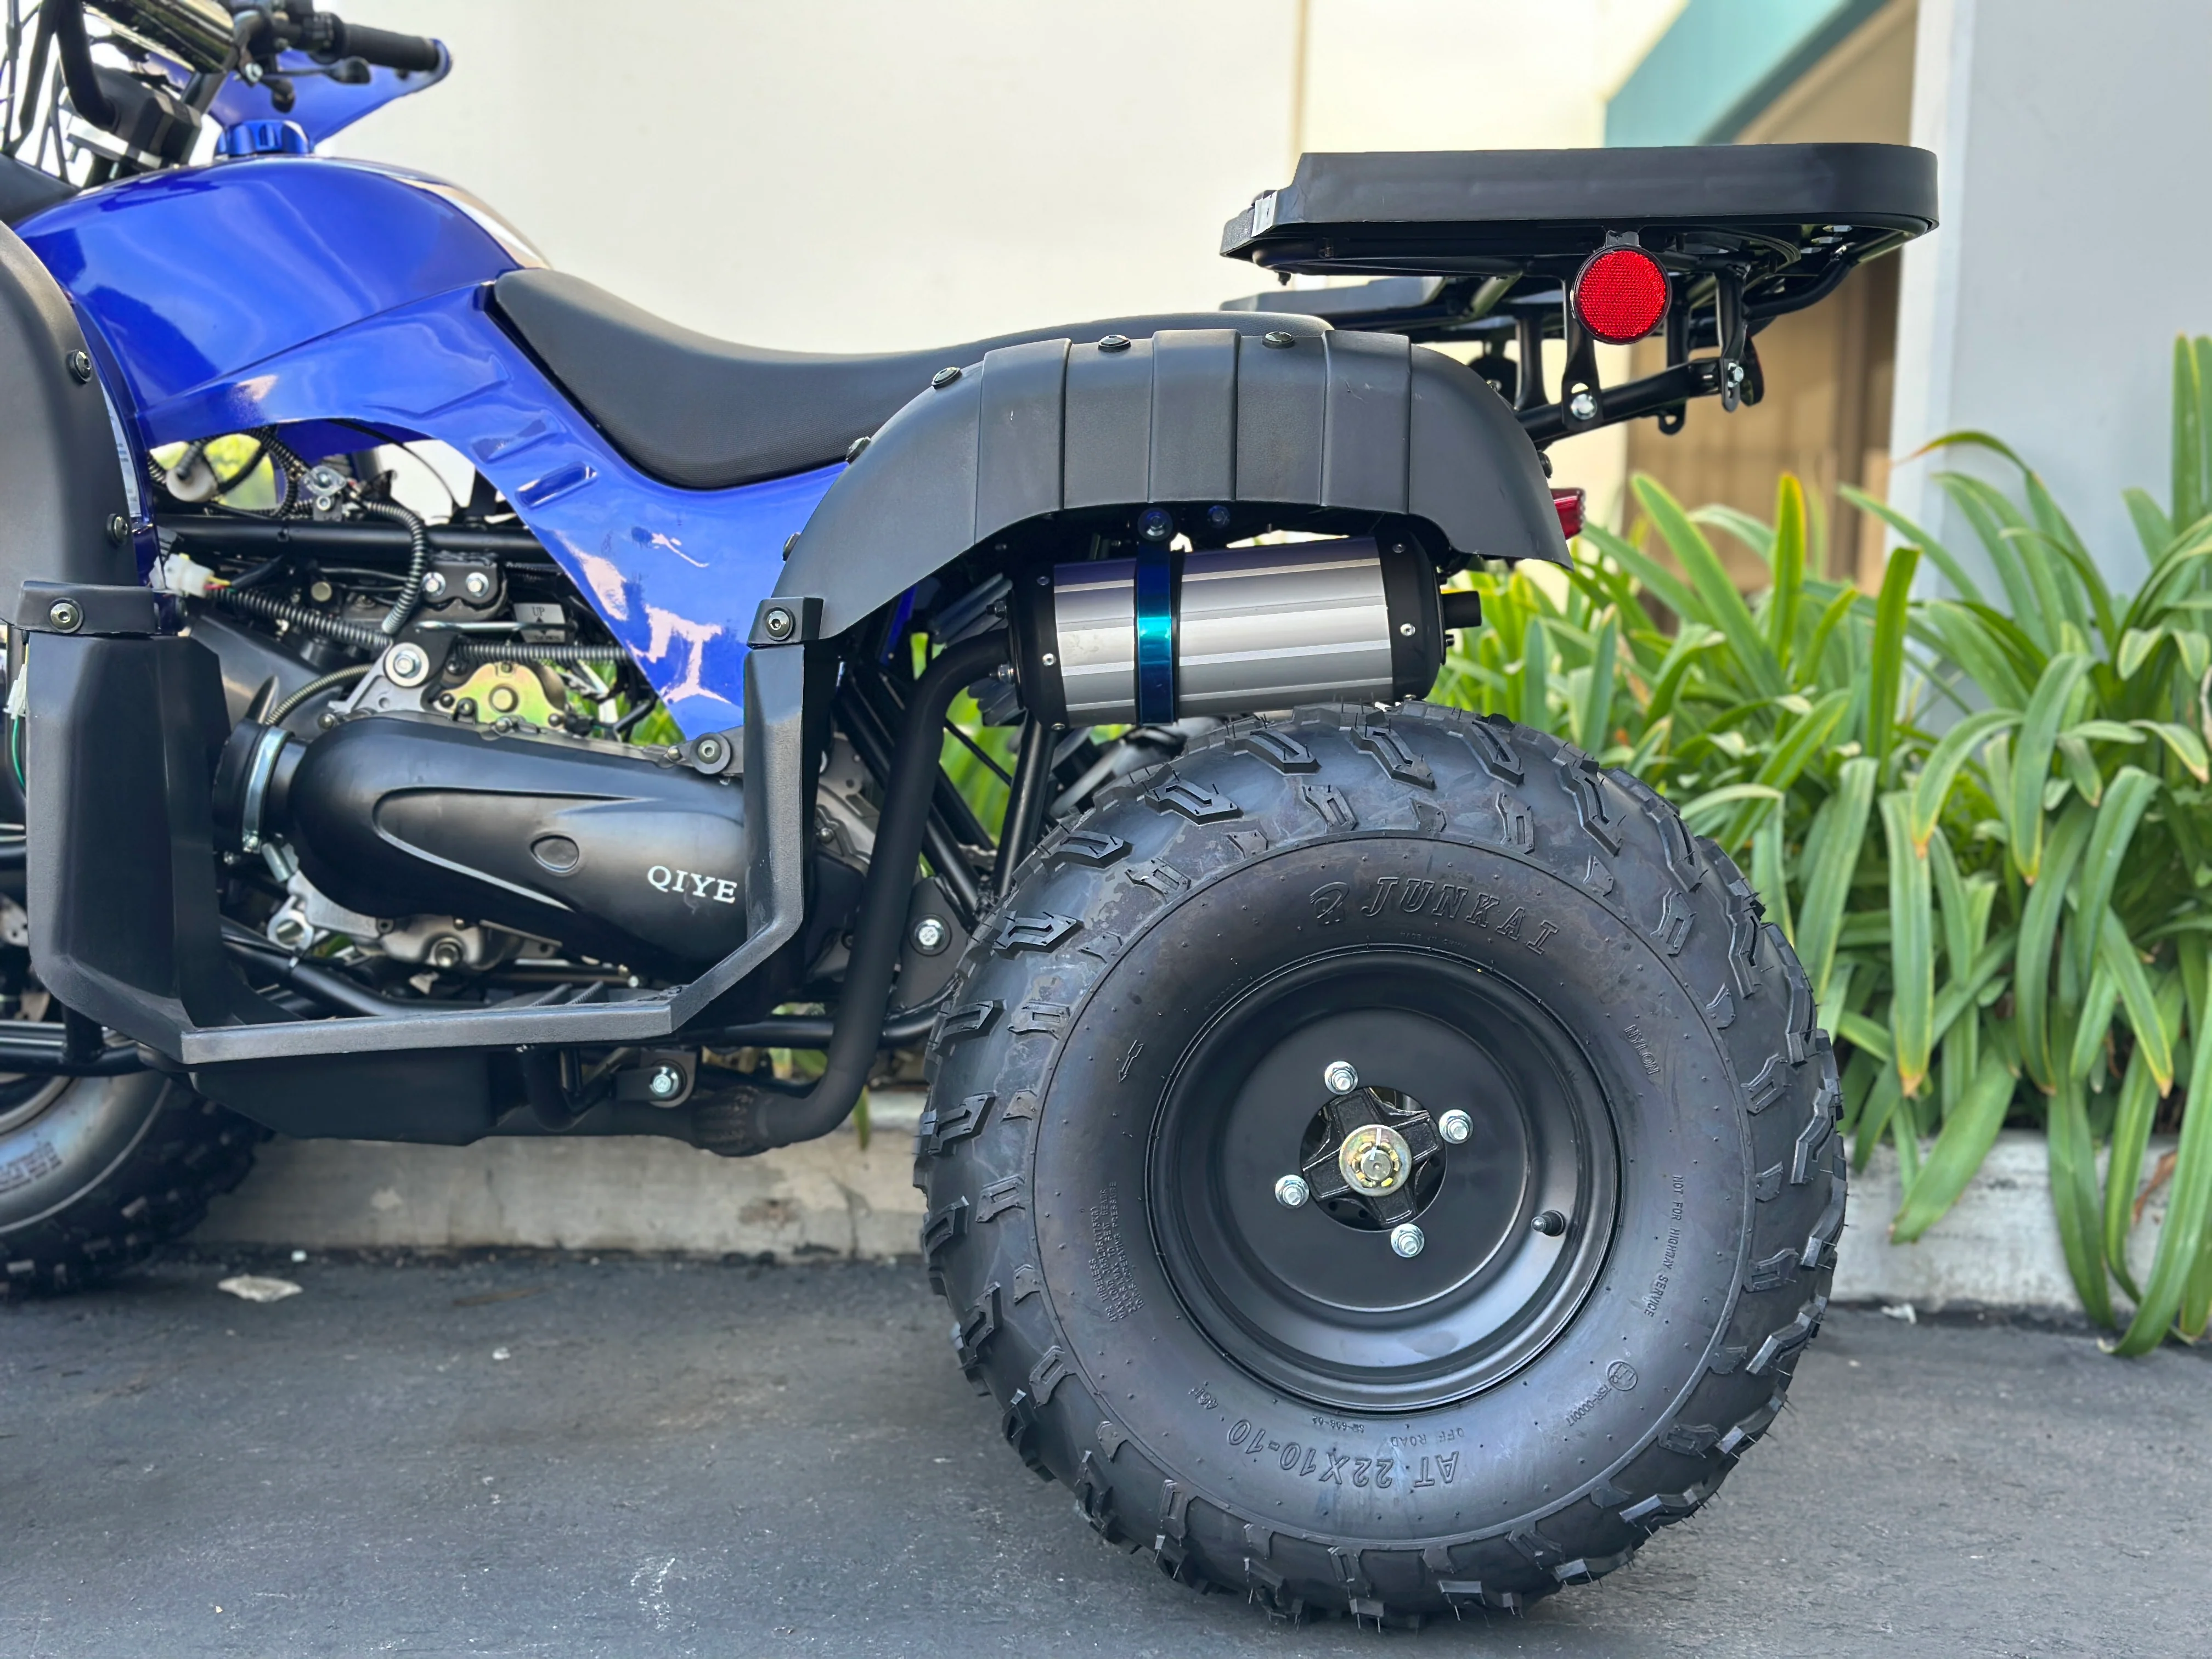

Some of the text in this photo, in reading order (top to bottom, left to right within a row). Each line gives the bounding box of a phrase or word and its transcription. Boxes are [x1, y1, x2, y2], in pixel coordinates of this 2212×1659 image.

[532, 606, 545, 616] UP
[647, 865, 737, 904] QIYE
[1361, 877, 1559, 955] JUNKAI
[1623, 1024, 1661, 1075] NYLON
[1109, 1181, 1119, 1227] PRESSURE
[1644, 1175, 1684, 1317] NOT FOR HIGHWAY SERVICE
[1088, 1259, 1105, 1302] TUBELESS
[1227, 1419, 1394, 1489] 22X10-10
[1390, 1426, 1465, 1448] OFF ROAD
[1413, 1451, 1460, 1488] AT
